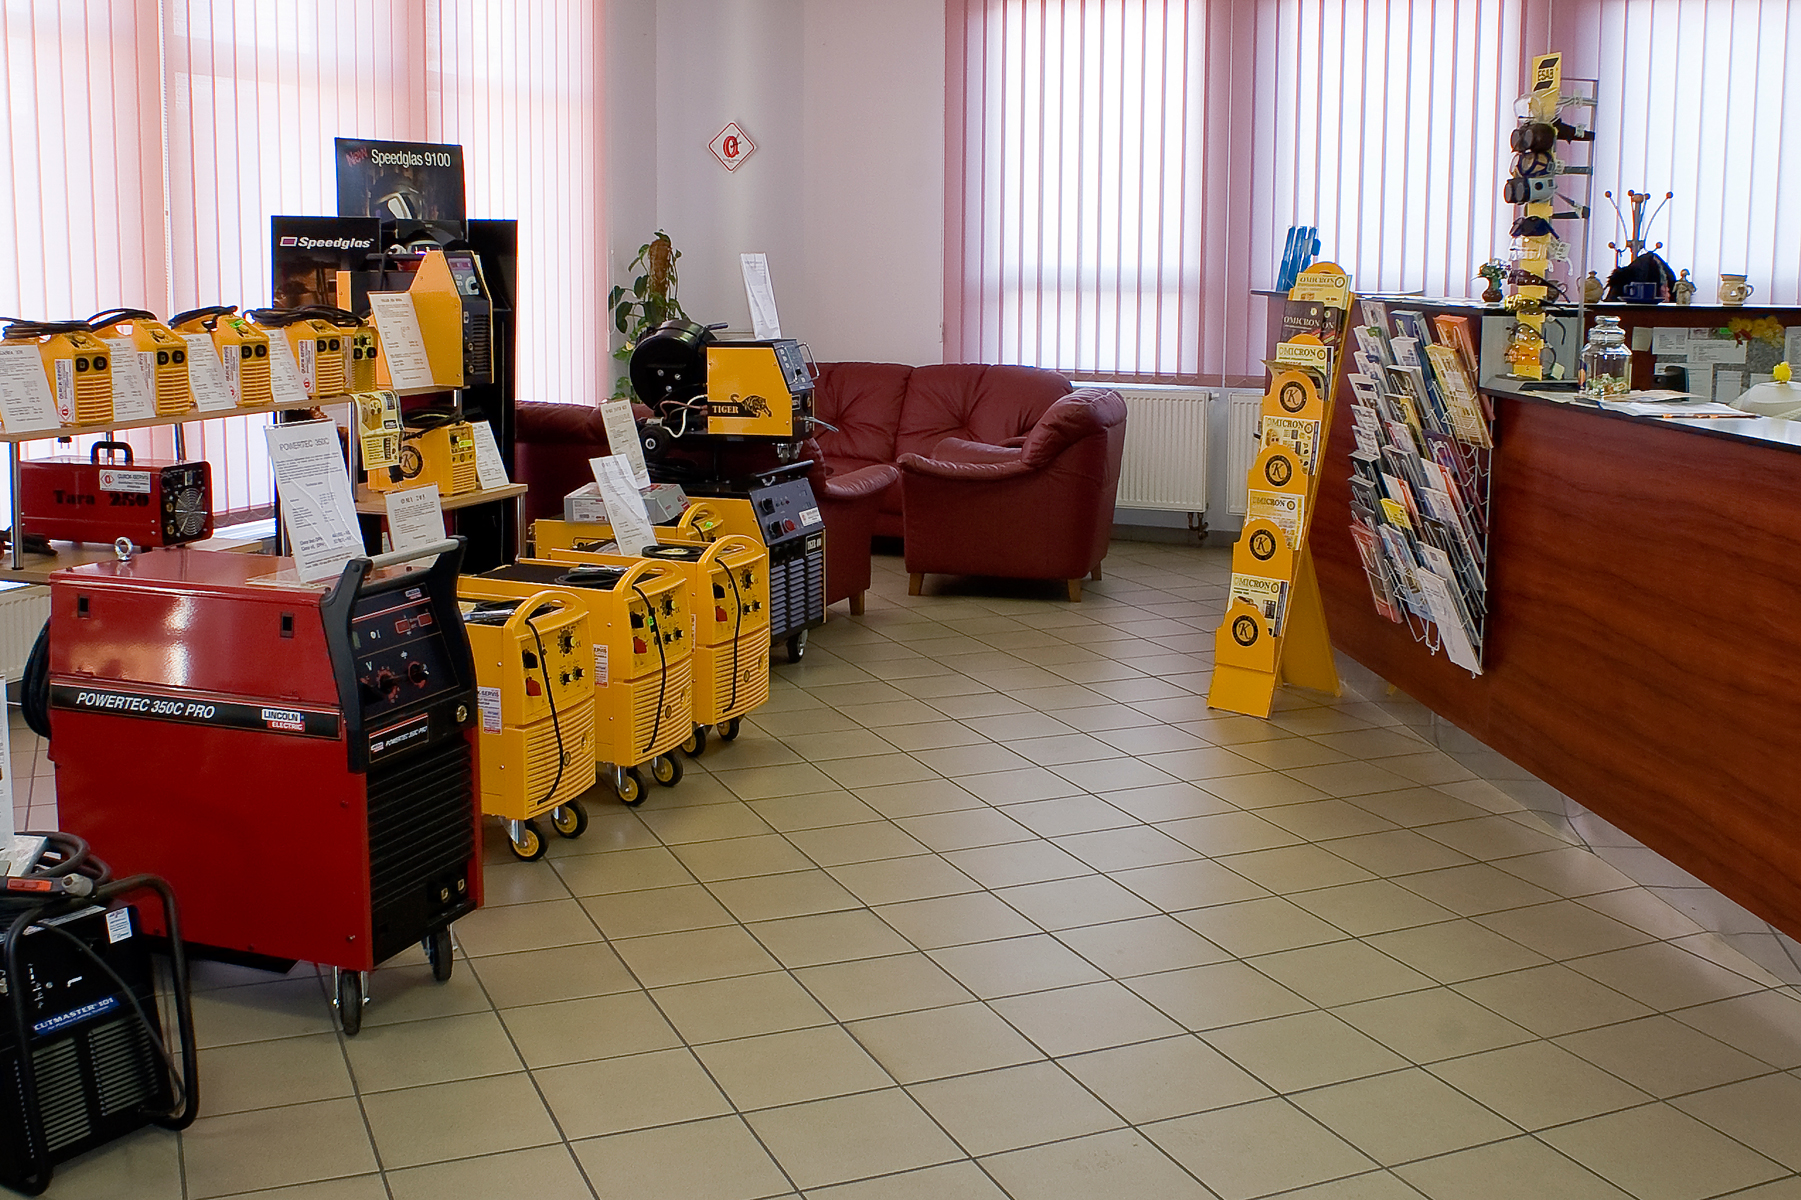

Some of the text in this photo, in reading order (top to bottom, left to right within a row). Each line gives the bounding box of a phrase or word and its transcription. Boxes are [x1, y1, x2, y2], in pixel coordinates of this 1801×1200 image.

[371, 149, 451, 168] Speedglas 9100
[298, 236, 371, 250] Speedglas
[1283, 315, 1320, 327] OMICRON
[1278, 346, 1316, 356] OMICRON
[712, 405, 739, 414] TIGER
[1266, 418, 1305, 429] OMICRON
[53, 489, 149, 507] Tara 250
[1234, 576, 1271, 589] OMICRON
[76, 692, 216, 719] POWERTEC 350C PRO
[263, 709, 300, 722] LINCOLN
[271, 721, 303, 731] ELECTRIC
[33, 1004, 96, 1031] CUTMASTER
